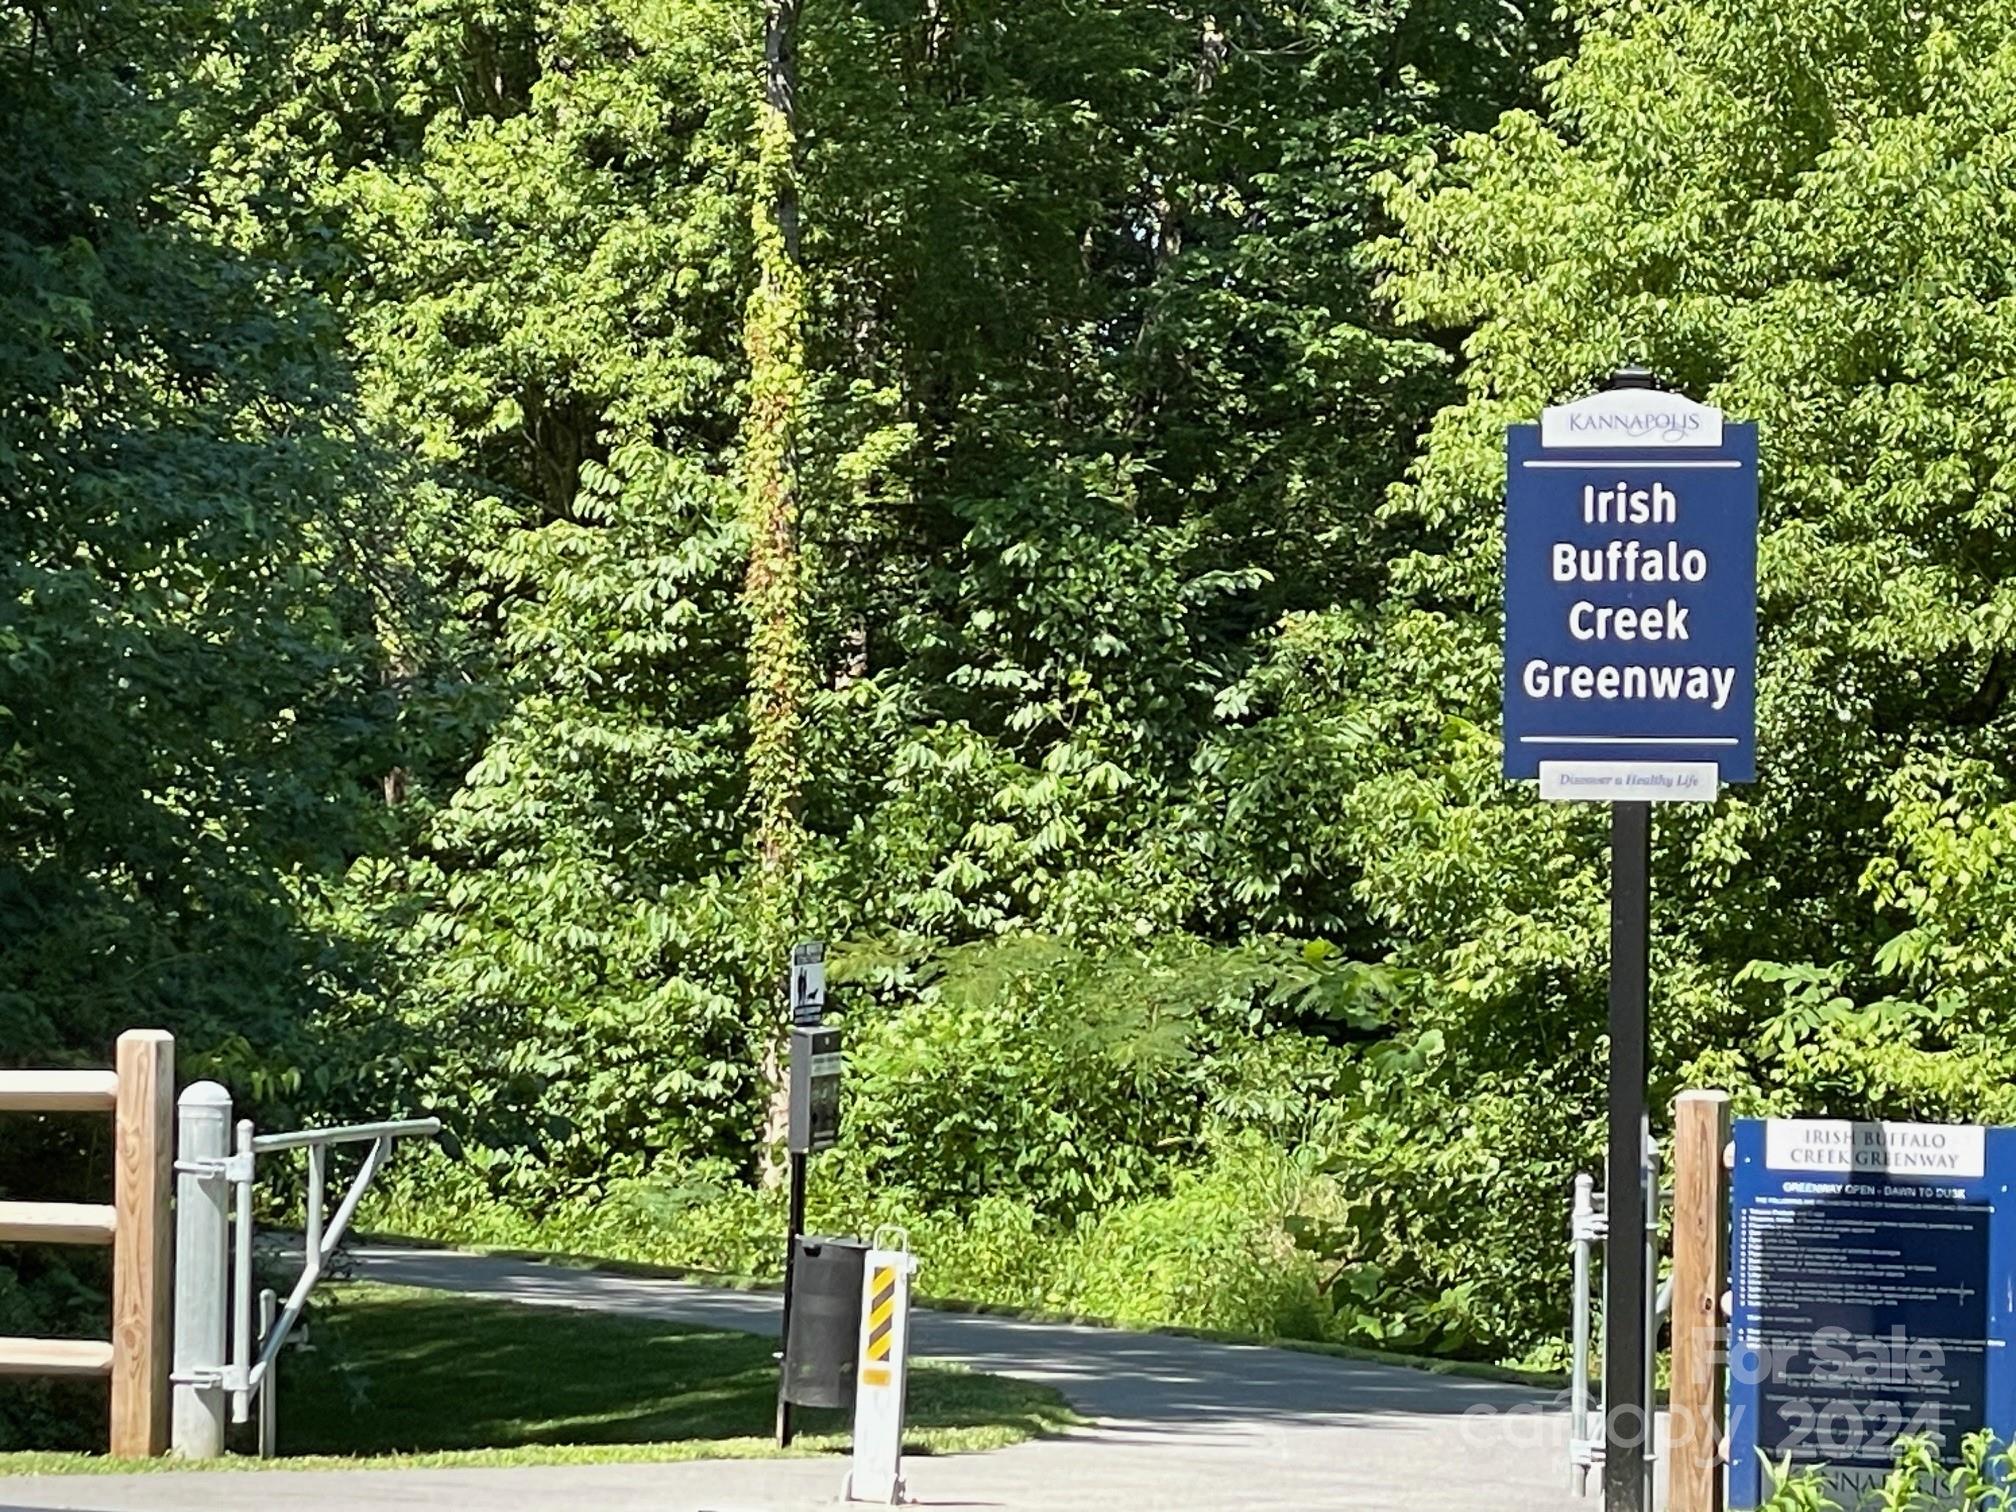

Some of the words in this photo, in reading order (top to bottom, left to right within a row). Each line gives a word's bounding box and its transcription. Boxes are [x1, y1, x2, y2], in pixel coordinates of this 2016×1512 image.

[1569, 413, 1700, 442] KANNAPOLIS
[1583, 481, 1677, 524] Irish
[1552, 540, 1708, 582] Buffalo
[1568, 598, 1690, 641] Creek
[1522, 659, 1736, 710] Greenway
[1626, 774, 1674, 788] Healthy
[1676, 774, 1699, 788] Life
[1804, 1128, 1856, 1145] IRISH
[1863, 1130, 1946, 1149] BUFFALO
[1790, 1148, 1849, 1165] CREEK
[1854, 1151, 1960, 1169] GREENWAY
[1782, 1181, 1843, 1193] GREENWAY
[1844, 1184, 1876, 1195] OPEN
[1884, 1186, 1916, 1197] DAWN
[1919, 1187, 1934, 1198] TO
[1936, 1188, 1966, 1200] DUSK
